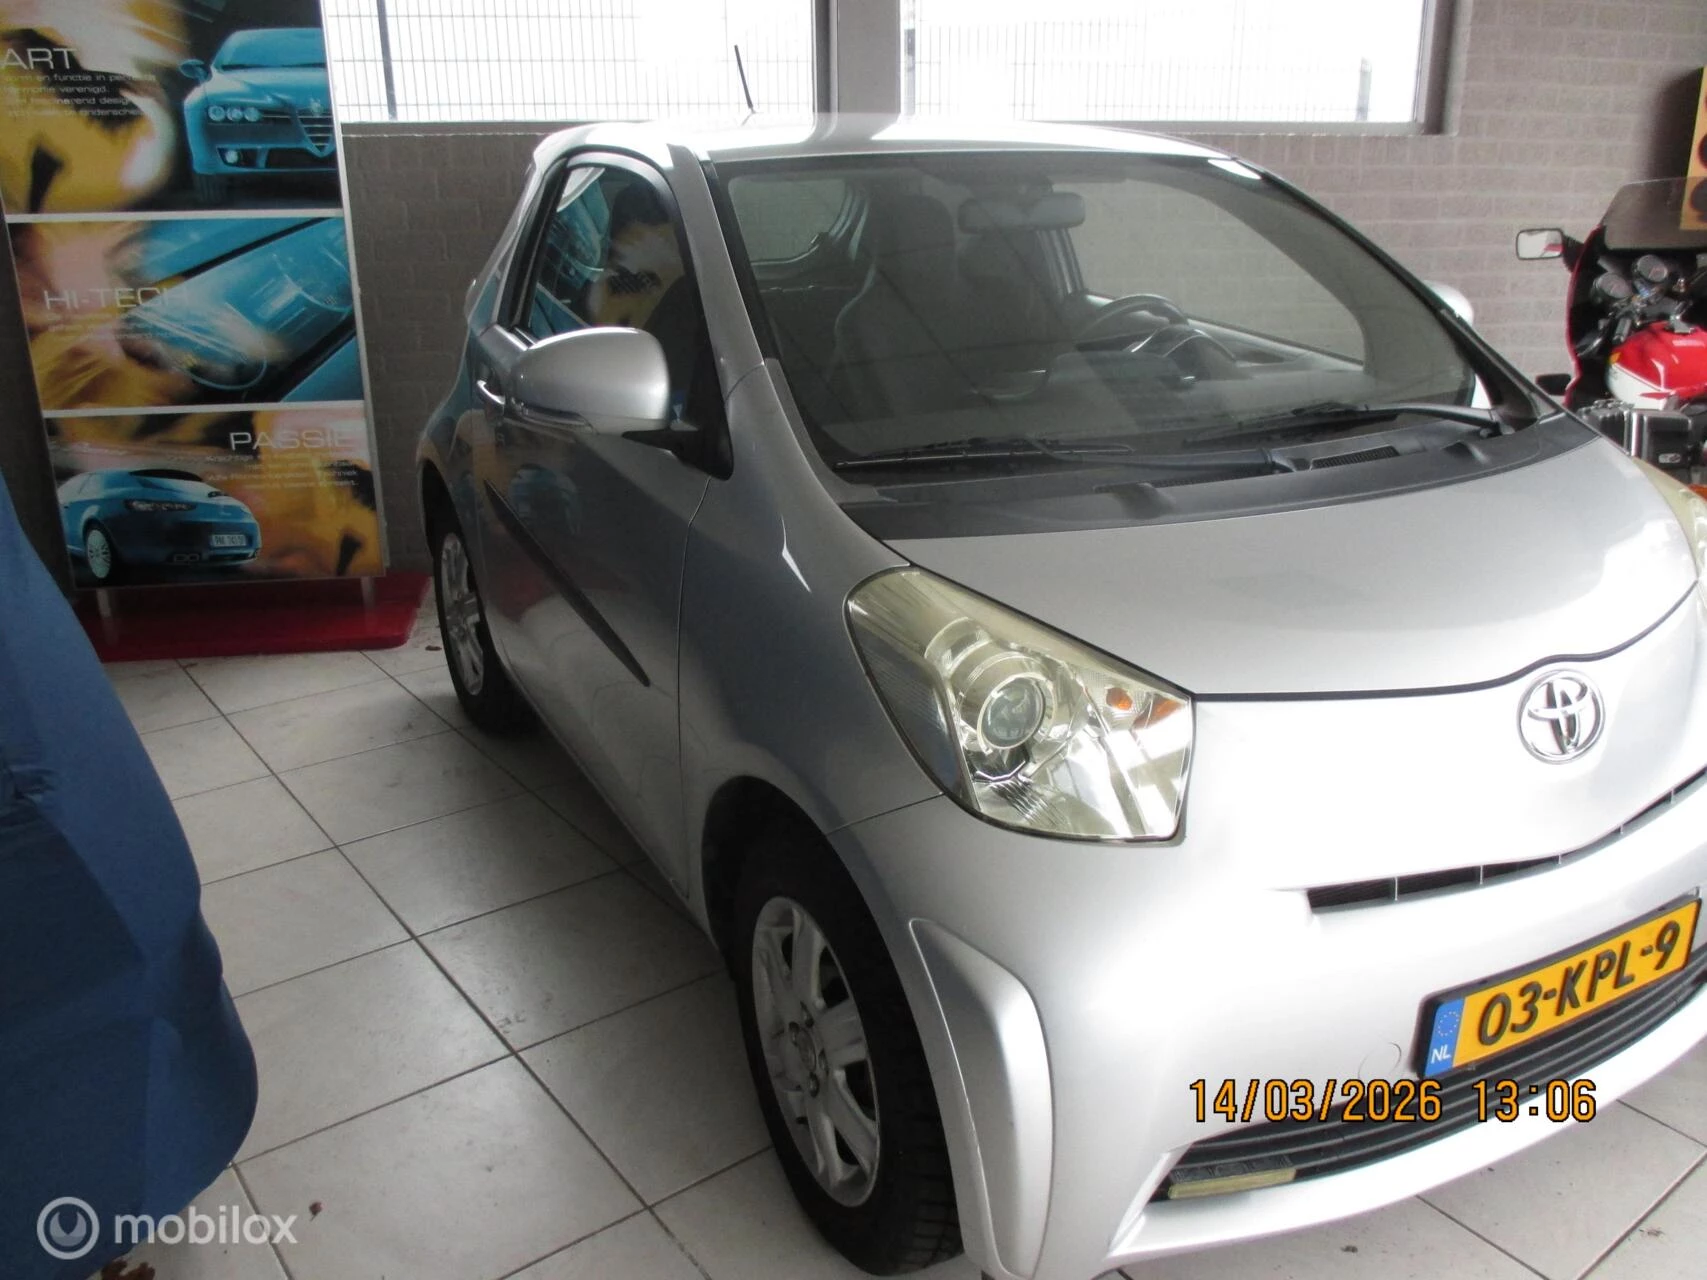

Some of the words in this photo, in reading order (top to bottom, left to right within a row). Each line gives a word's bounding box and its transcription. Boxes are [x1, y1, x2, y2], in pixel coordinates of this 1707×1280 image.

[0, 47, 76, 70] ART
[229, 428, 358, 451] PASSIE
[1477, 919, 1681, 1047] 03-KPL-9
[1430, 1045, 1451, 1064] NL
